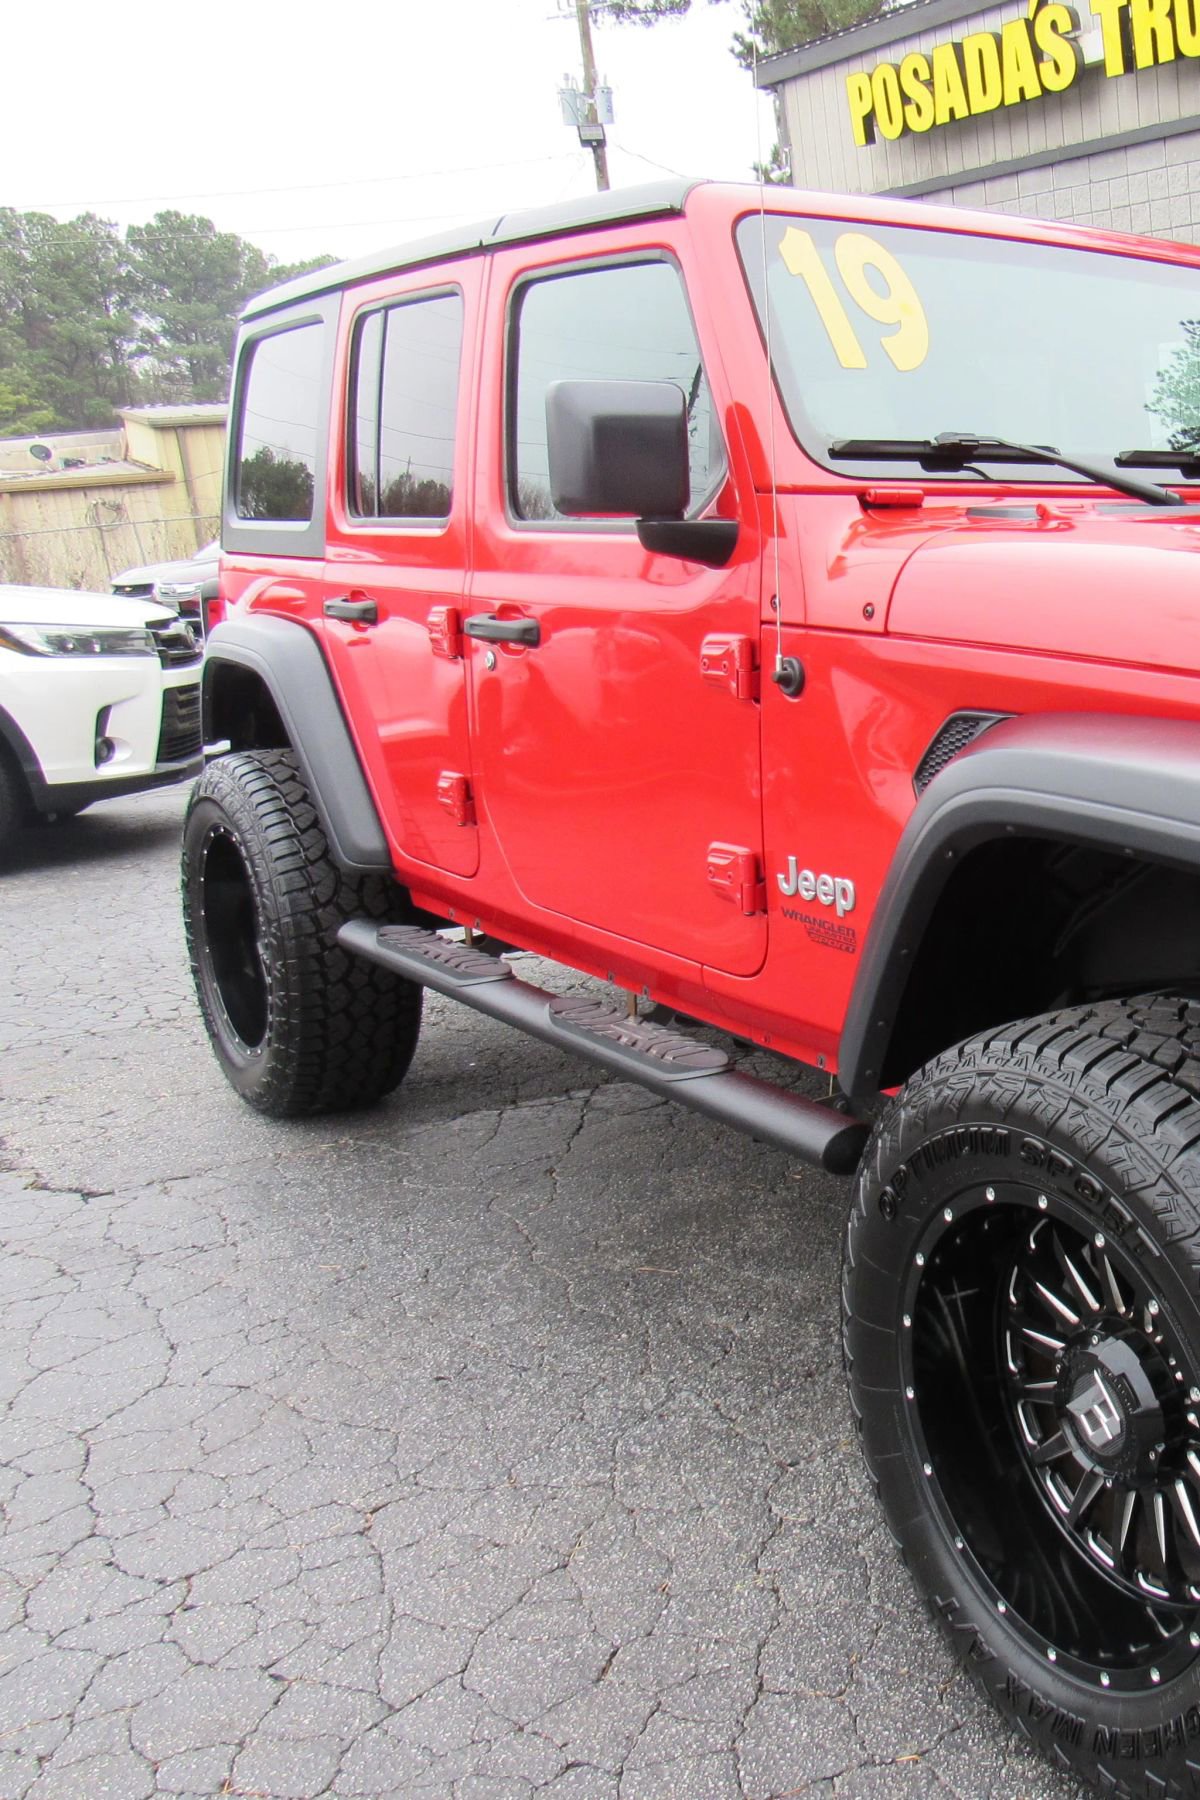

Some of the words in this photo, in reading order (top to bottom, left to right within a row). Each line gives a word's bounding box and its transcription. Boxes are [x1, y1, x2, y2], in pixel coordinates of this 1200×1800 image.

[846, 0, 1079, 147] POSADA'S
[779, 226, 928, 372] 19
[777, 856, 856, 917] Jeep
[781, 906, 856, 939] WRANGLER
[878, 1126, 1012, 1222] OPTIMUM
